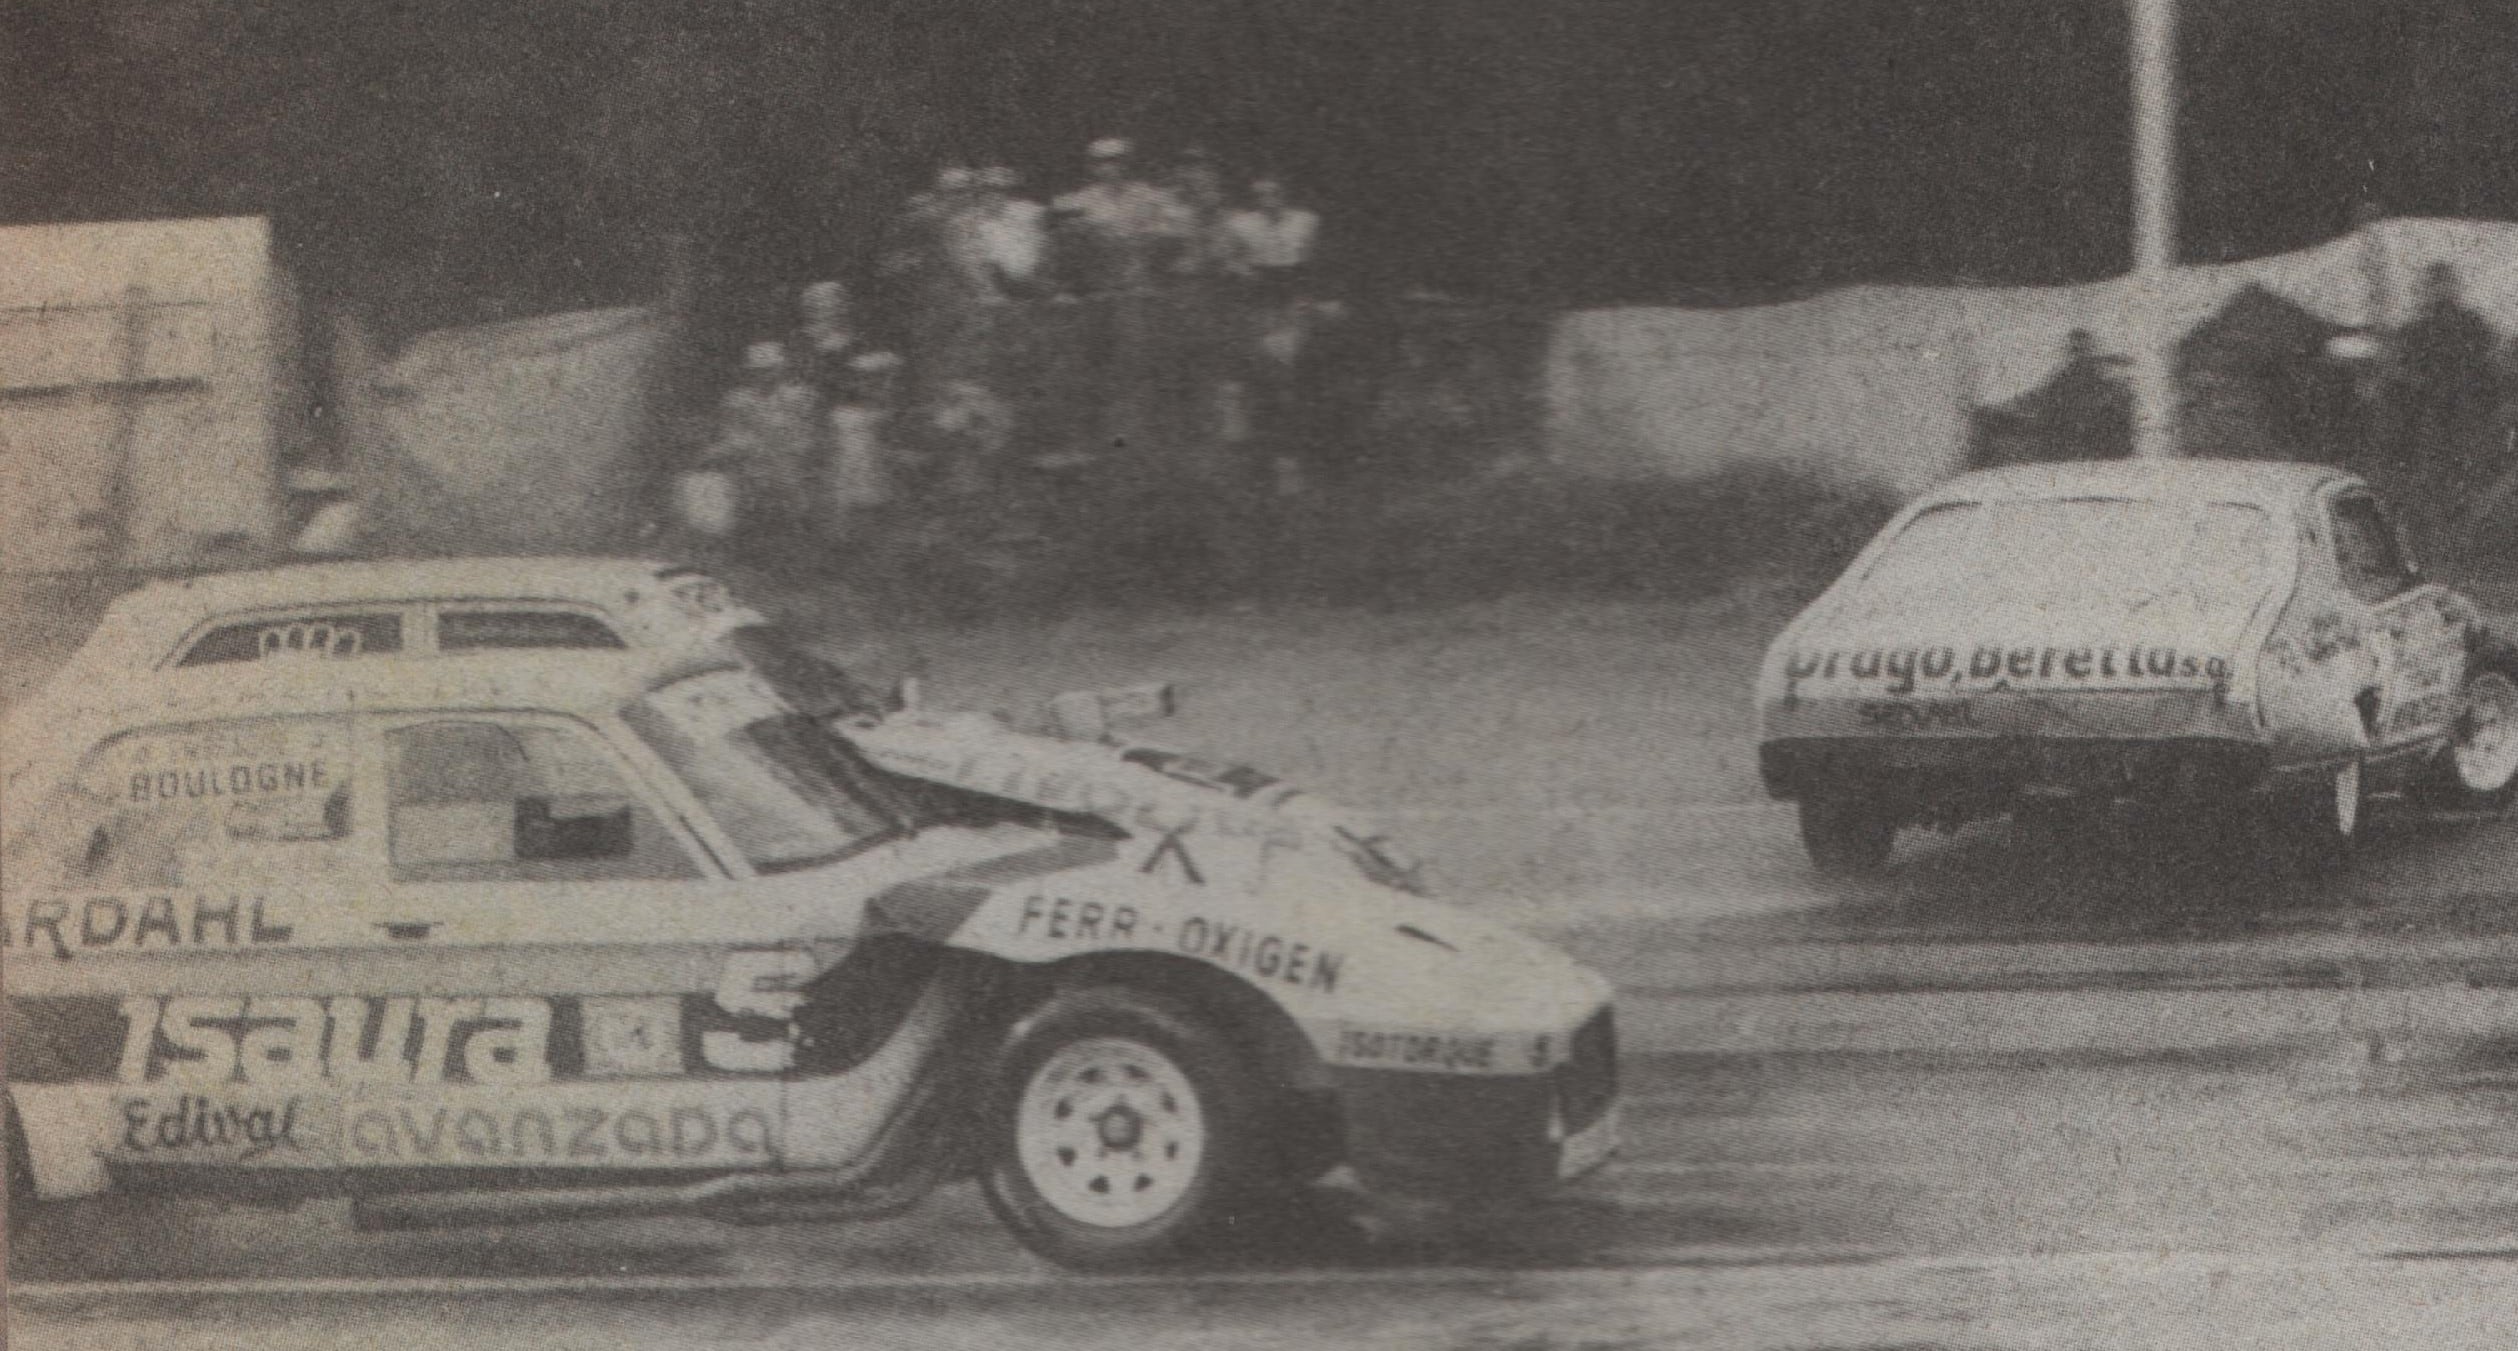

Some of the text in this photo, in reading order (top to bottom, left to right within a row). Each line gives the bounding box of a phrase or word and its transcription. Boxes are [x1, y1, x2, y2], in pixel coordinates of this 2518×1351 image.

[1017, 895, 1140, 940] FERR
[1178, 914, 1345, 994] OXIGEN
[122, 1094, 302, 1160] Edival
